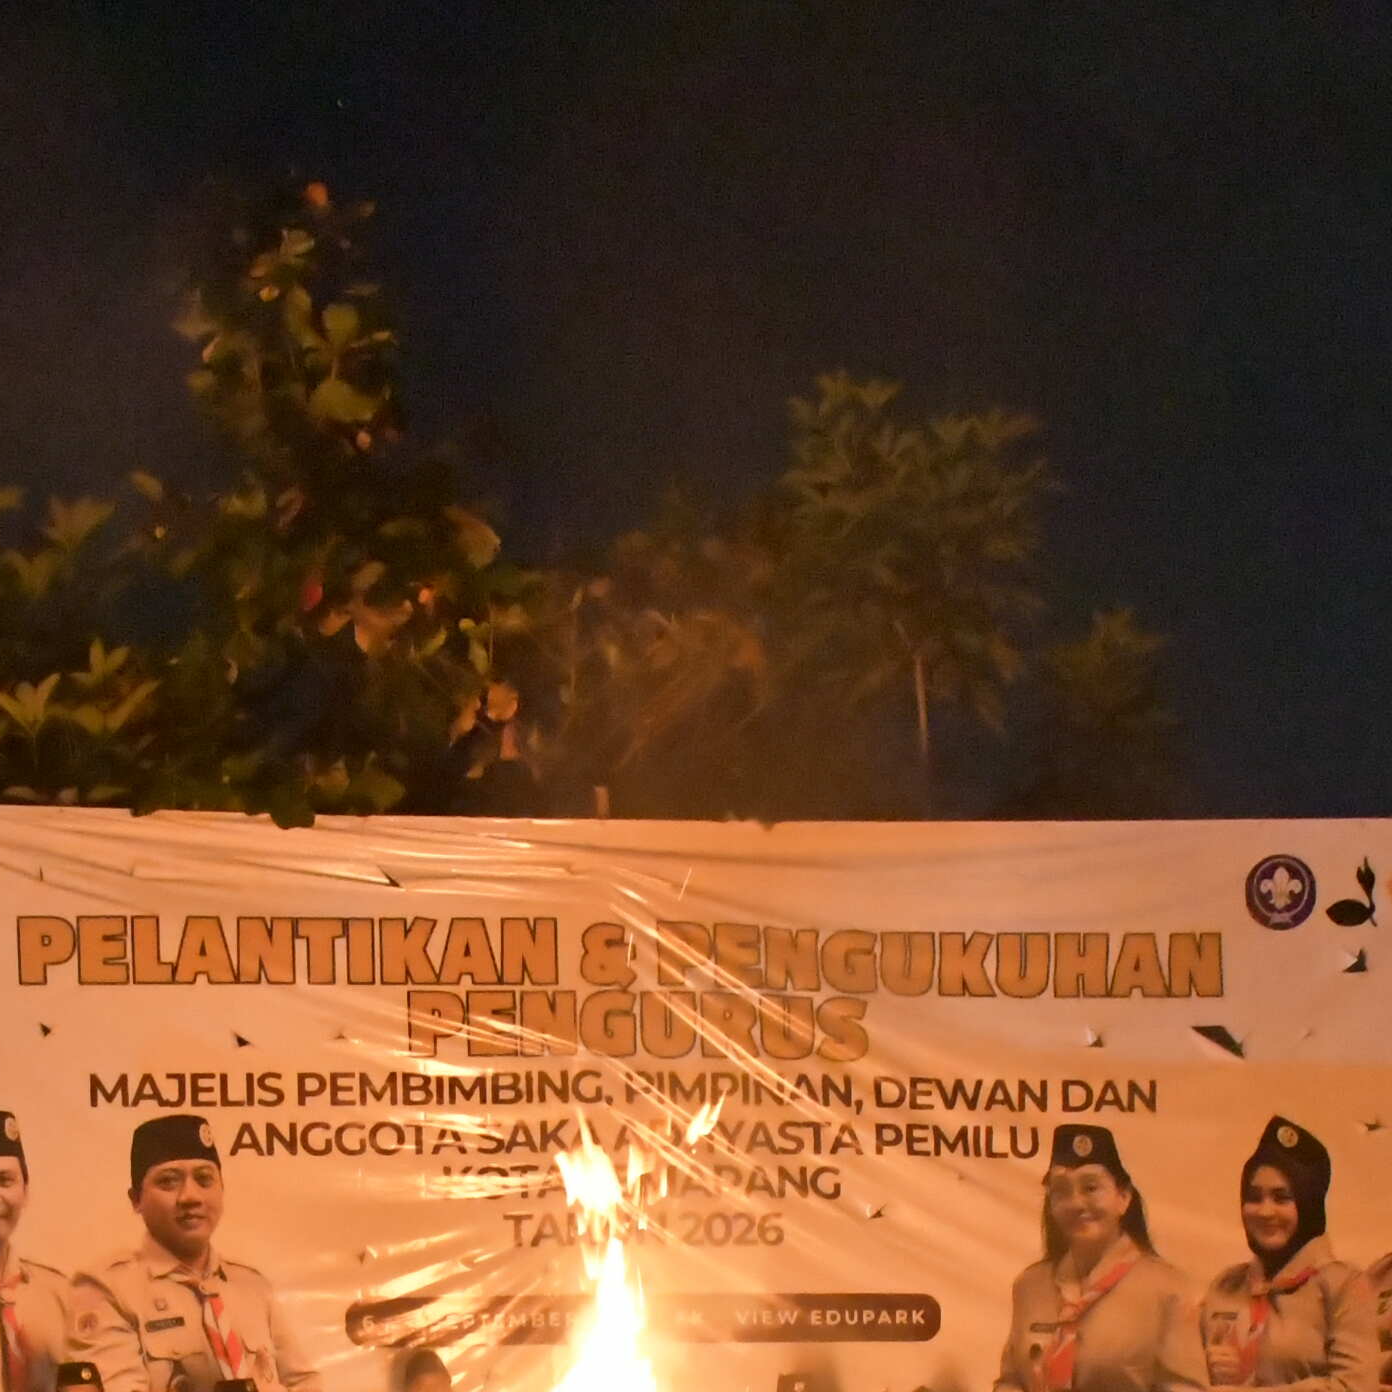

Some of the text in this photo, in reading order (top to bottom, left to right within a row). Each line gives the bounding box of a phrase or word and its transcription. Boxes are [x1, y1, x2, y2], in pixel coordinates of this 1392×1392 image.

[16, 914, 1224, 999] PELANTIKAN & PENGUKUHAN
[407, 989, 870, 1063] PENGURUS
[89, 1069, 1158, 1115] MAJELIS PEMBIMBING, PIMPINAN, DEWAN DAN
[229, 1120, 469, 1157] ANGGOTA
[477, 1118, 601, 1155] SAKA
[874, 1121, 1039, 1159] PEMILU
[677, 1211, 786, 1248] 2026
[734, 1309, 926, 1327] VIEW EDUPARK
